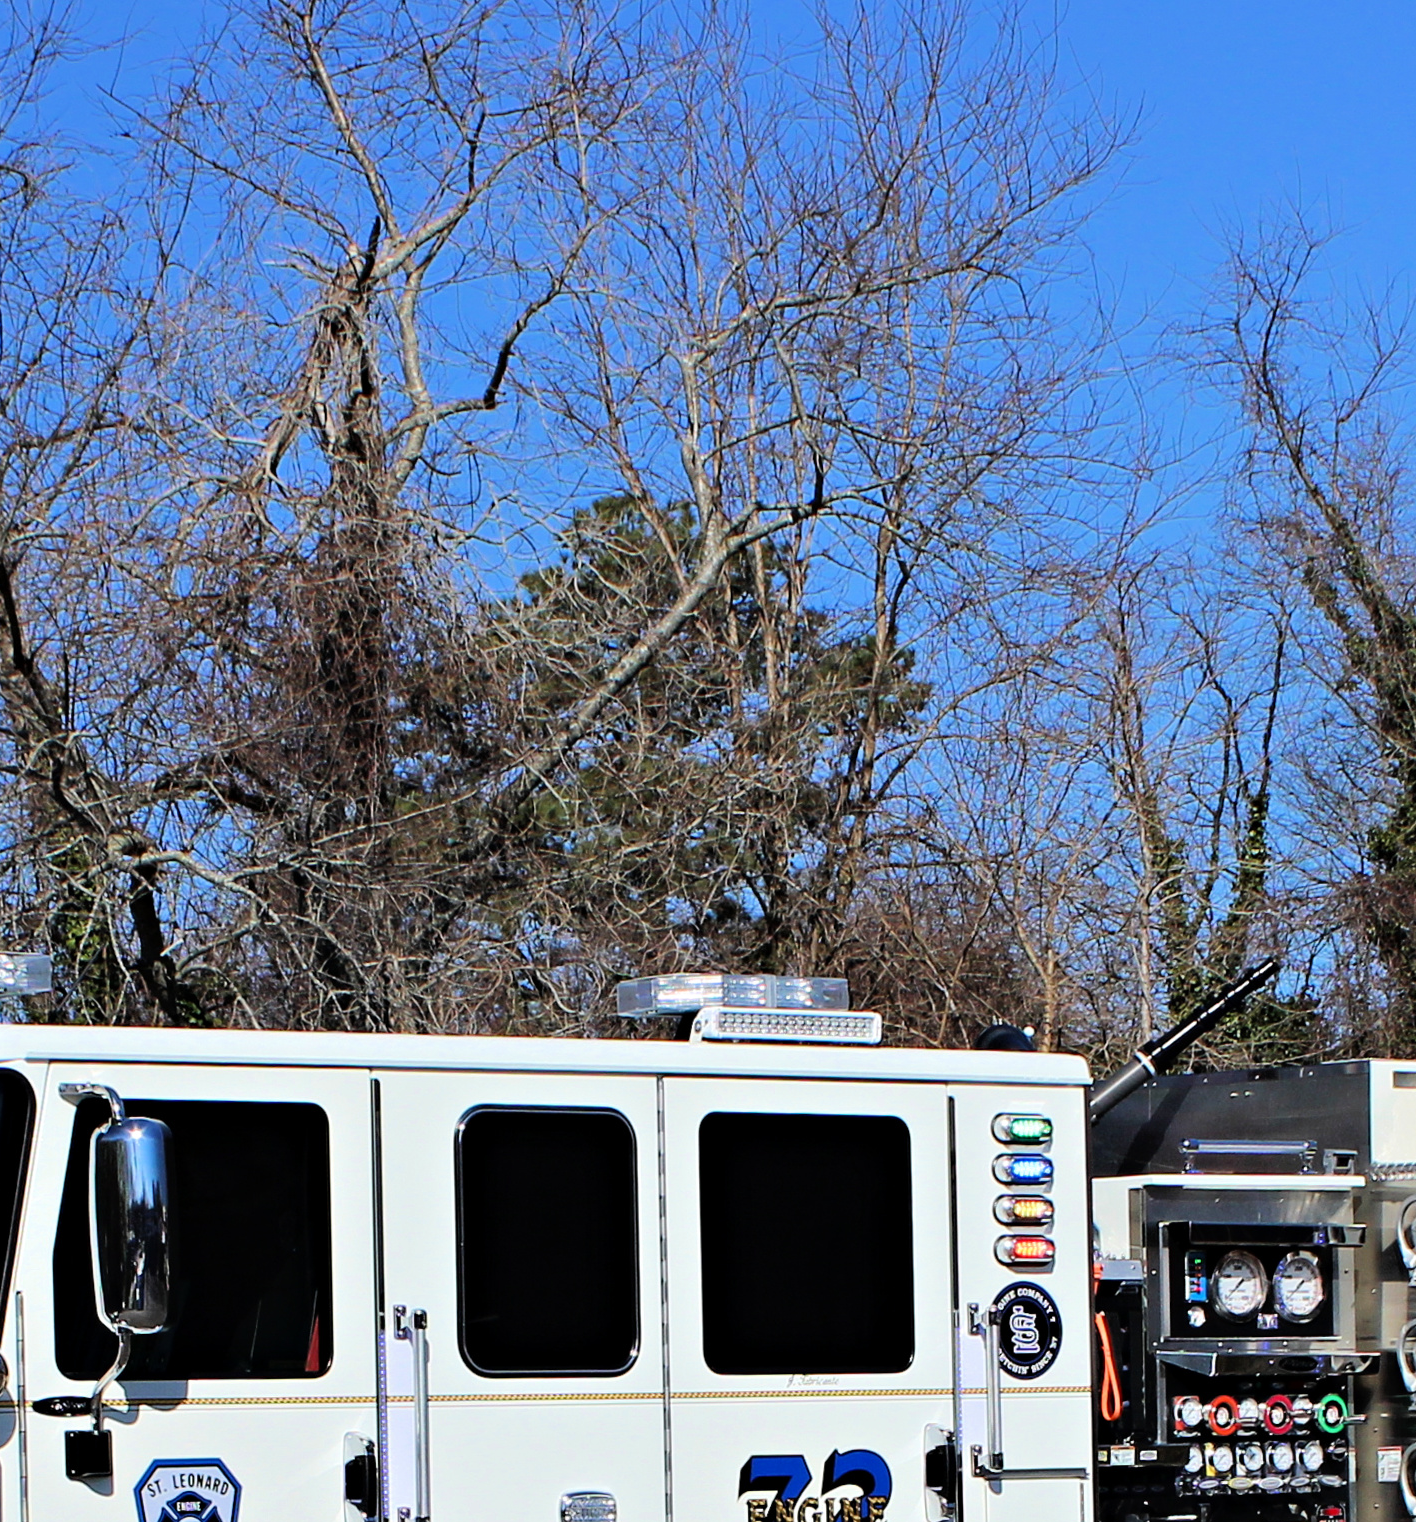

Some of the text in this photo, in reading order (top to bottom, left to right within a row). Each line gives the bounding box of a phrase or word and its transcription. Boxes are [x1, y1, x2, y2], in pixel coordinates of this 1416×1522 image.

[1017, 1288, 1054, 1314] COMPANY
[1031, 1350, 1053, 1374] SINCE
[147, 1473, 230, 1498] ST. LEONARD
[176, 1501, 202, 1512] ENGINE
